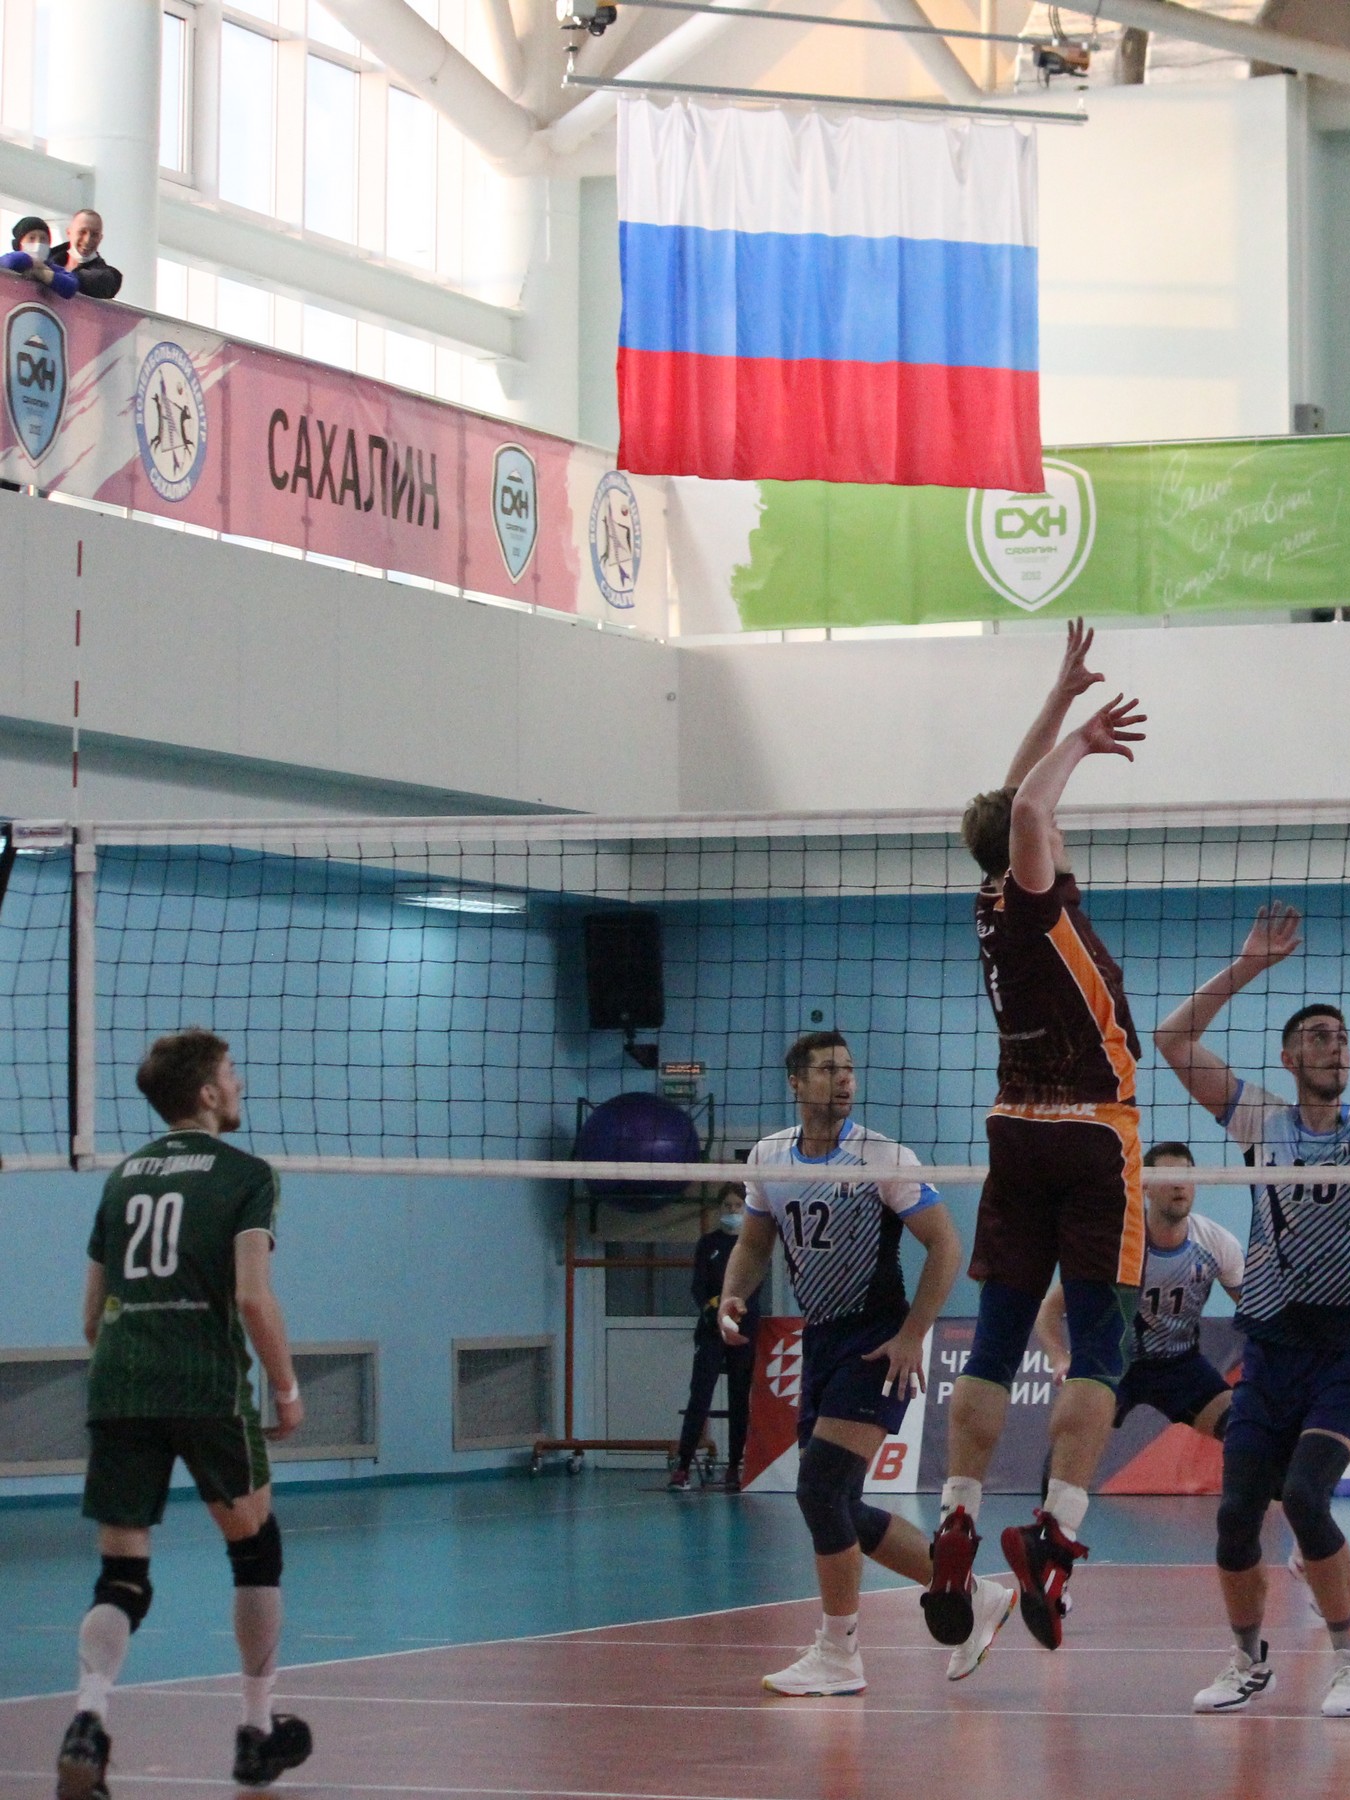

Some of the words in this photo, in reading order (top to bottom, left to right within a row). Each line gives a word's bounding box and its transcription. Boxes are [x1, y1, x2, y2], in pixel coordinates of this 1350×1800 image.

[267, 408, 441, 531] САХАЛИН
[124, 1191, 184, 1280] 20
[785, 1200, 833, 1250] 12
[1145, 1286, 1186, 1317] 11
[937, 1381, 1051, 1405] РИИ
